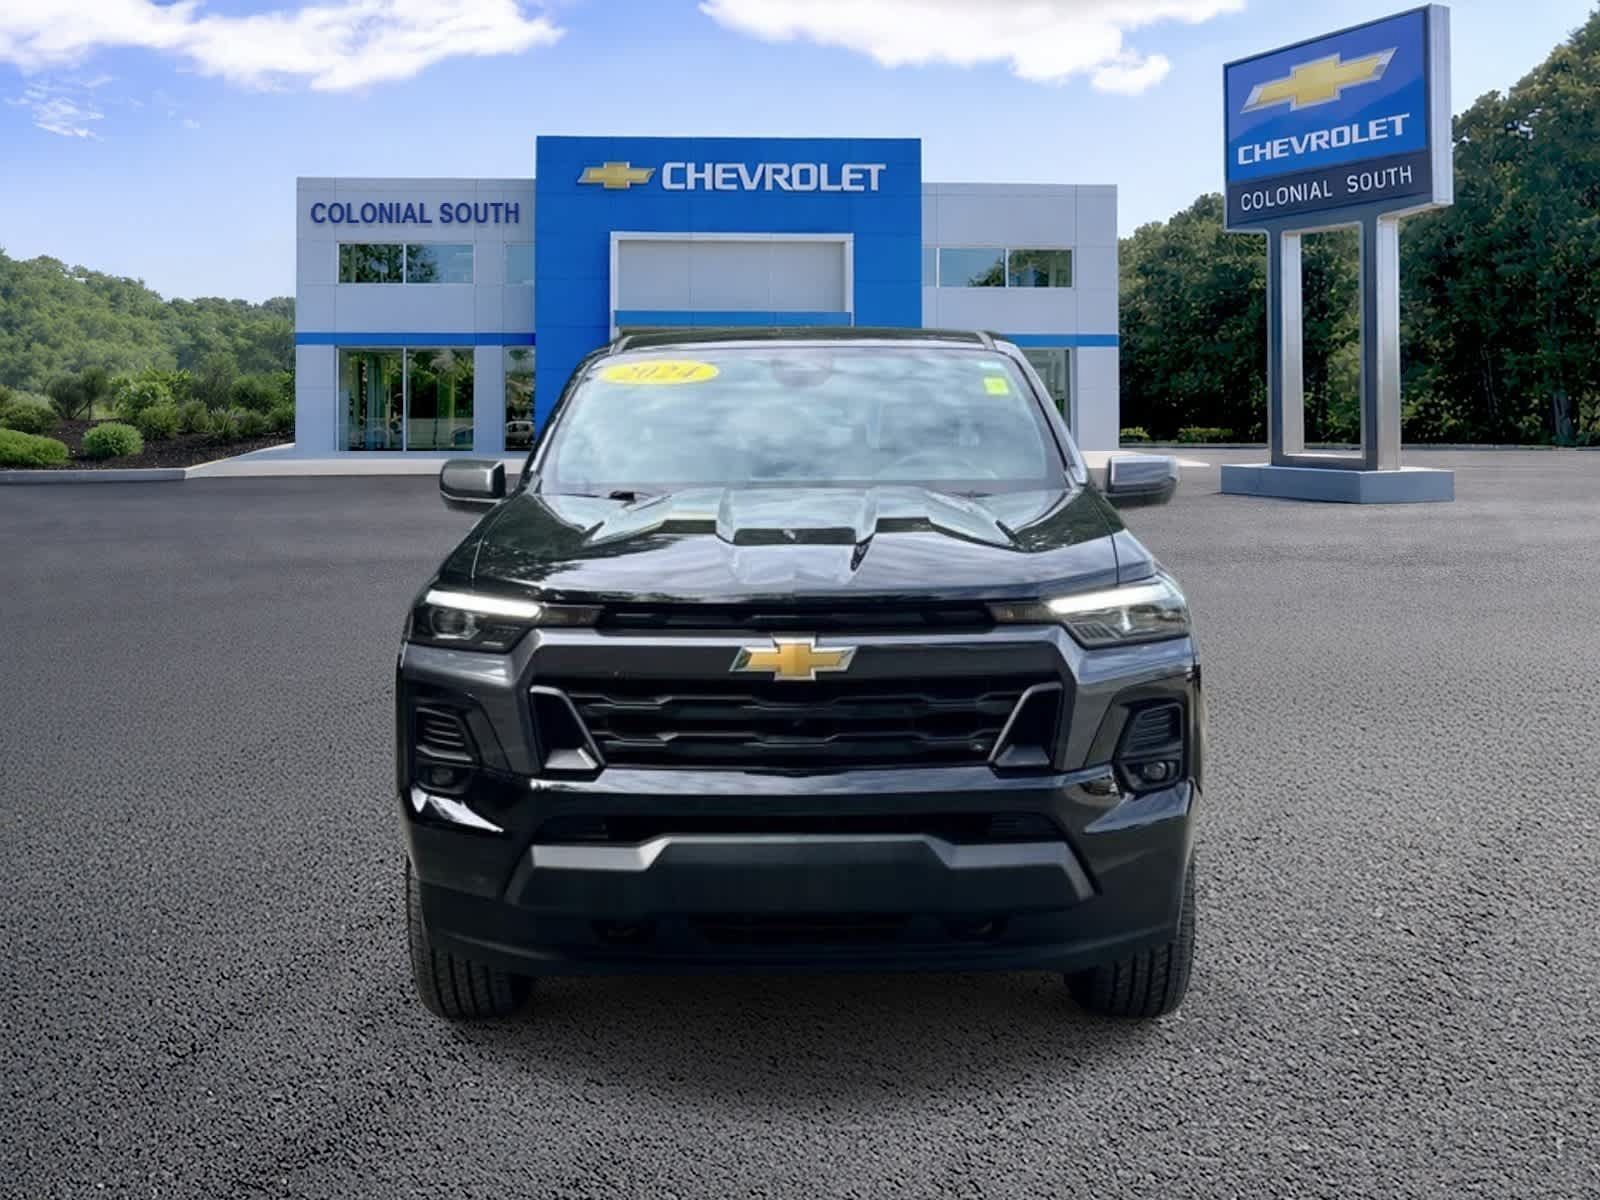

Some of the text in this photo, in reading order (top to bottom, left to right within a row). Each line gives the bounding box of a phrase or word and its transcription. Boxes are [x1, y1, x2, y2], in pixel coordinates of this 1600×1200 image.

[1238, 113, 1410, 165] CHEVROLET
[662, 161, 887, 192] CHEVROLET
[1240, 165, 1413, 211] COLONIAL SOUTH
[310, 202, 520, 224] COLONIAL SOUTH
